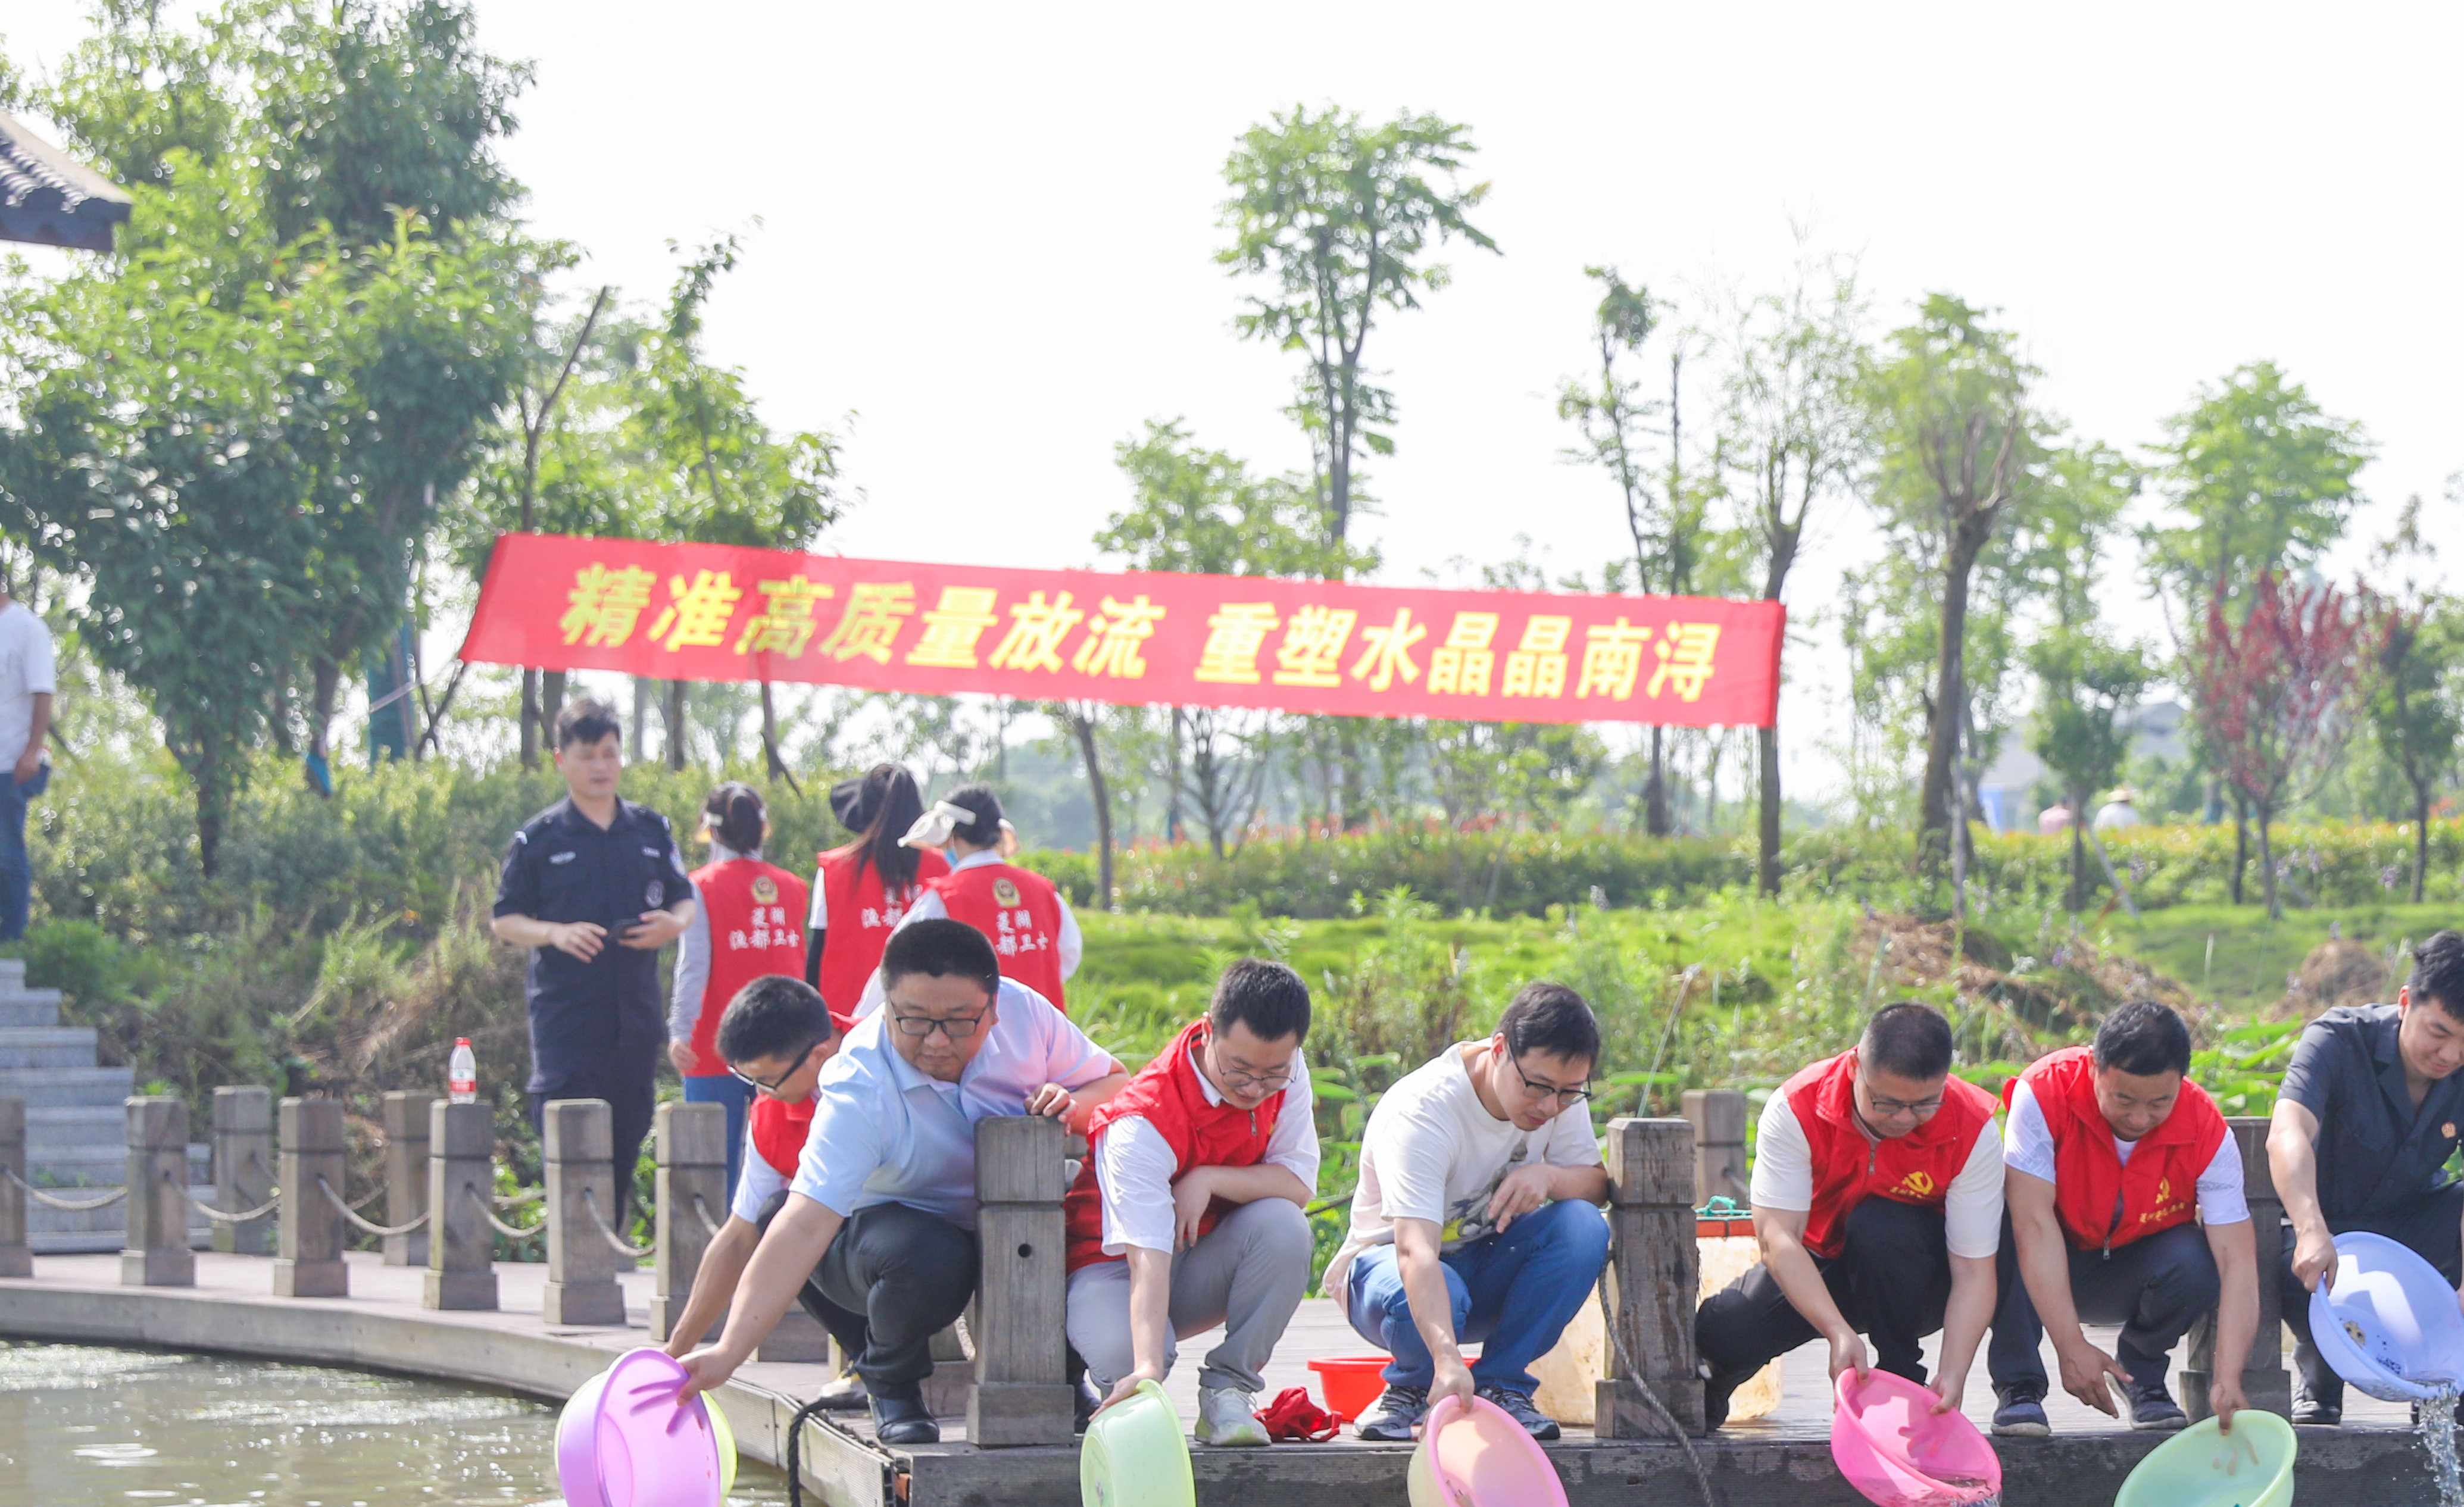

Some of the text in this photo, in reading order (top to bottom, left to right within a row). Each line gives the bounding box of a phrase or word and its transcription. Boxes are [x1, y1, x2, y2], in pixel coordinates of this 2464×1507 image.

[558, 562, 1721, 703] 精准高质量放流 重塑水晶晶南浔
